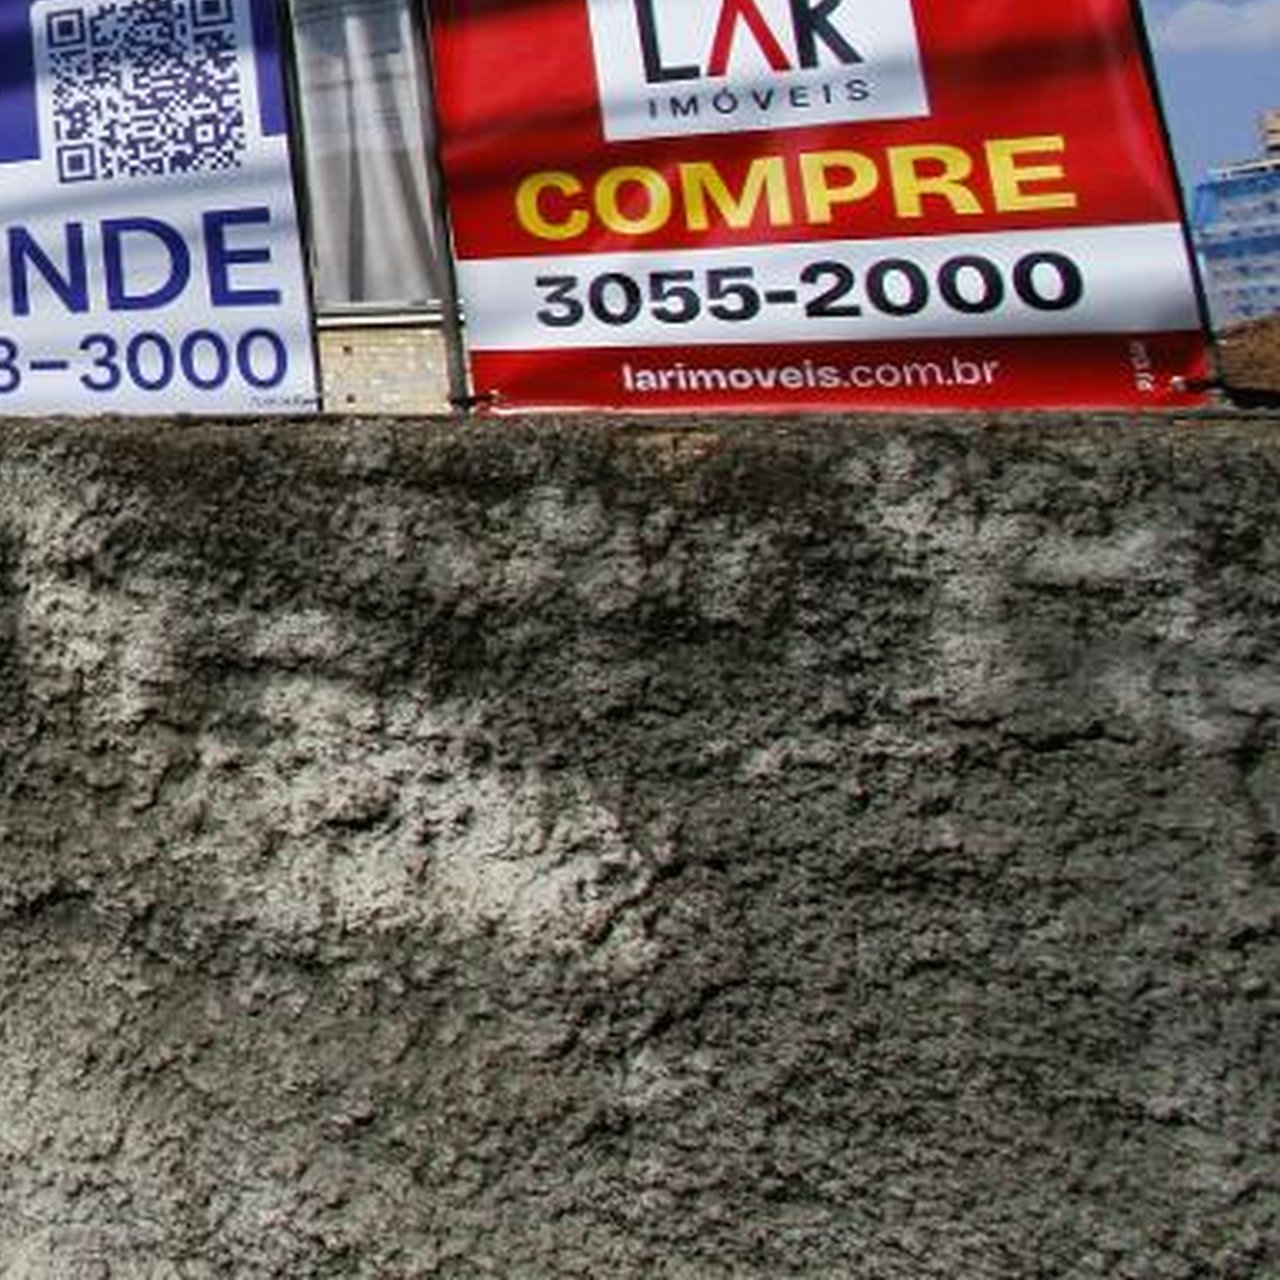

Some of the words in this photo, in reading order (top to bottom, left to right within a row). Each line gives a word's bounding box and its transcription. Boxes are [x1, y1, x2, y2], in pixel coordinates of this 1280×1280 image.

[648, 77, 871, 119] IMÓVEIS
[515, 135, 1077, 242] COMPRE
[534, 251, 1084, 329] 3055-2000
[623, 356, 1000, 394] larimoveis.com.br
